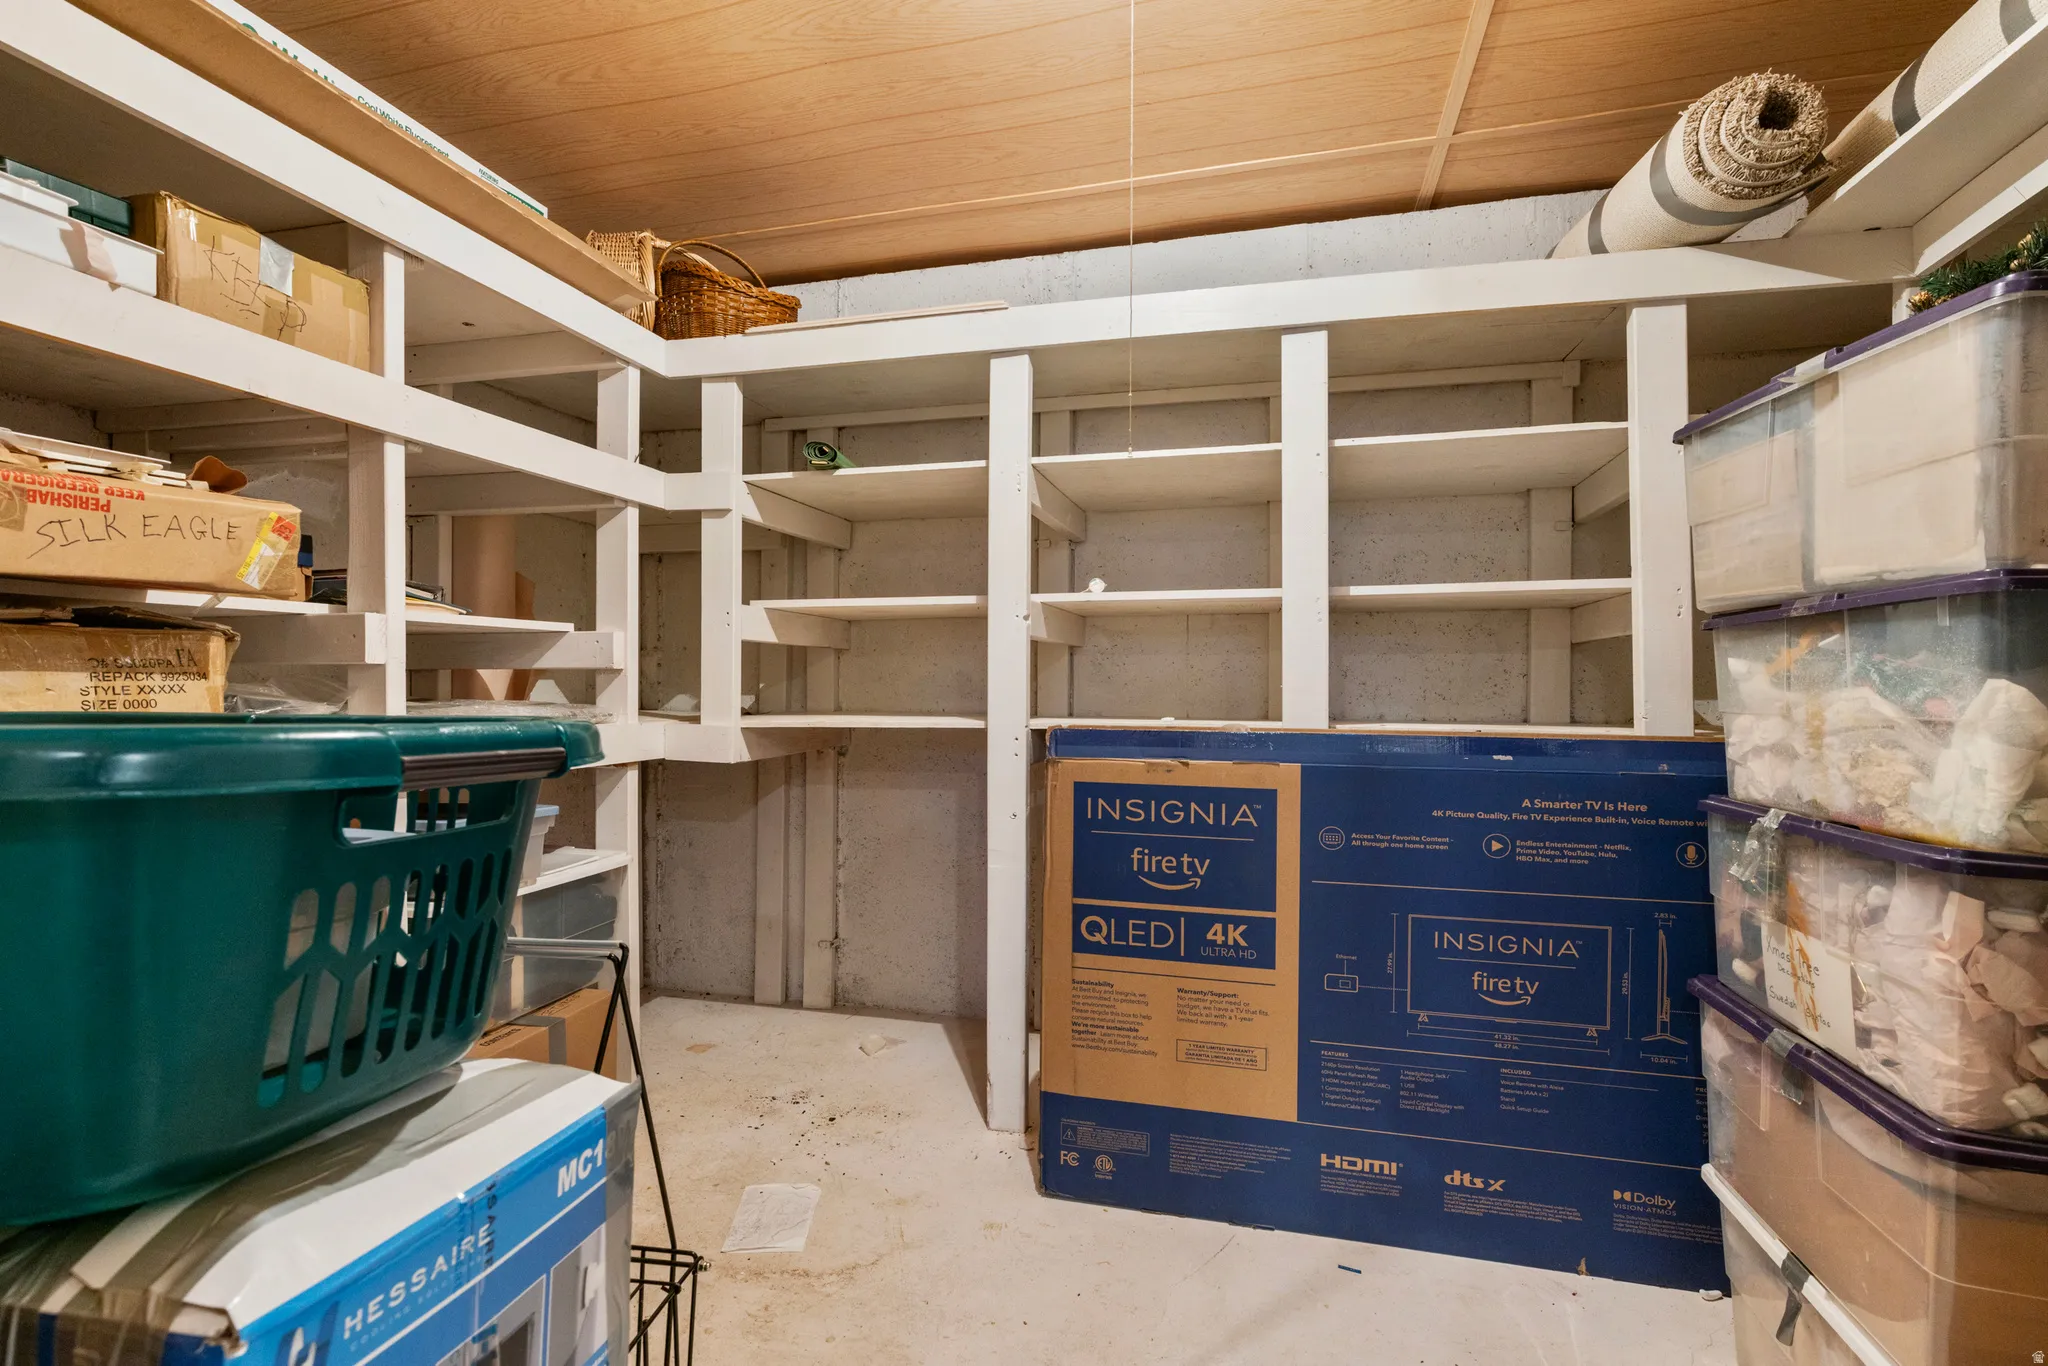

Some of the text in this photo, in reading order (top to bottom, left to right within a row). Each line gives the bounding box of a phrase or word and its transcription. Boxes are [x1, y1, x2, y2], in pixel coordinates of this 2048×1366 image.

[105, 486, 145, 501] KEEP
[26, 514, 242, 559] SILK EAGLE
[89, 672, 208, 682] REPACK 9925034
[80, 684, 187, 697] STYLE XXXXX
[81, 698, 158, 711] SIZE 0000
[1522, 799, 1648, 812] A Smarter TV Is Here
[1446, 811, 1475, 819] Picture
[1477, 811, 1511, 821] Quality,
[1530, 813, 1541, 821] TV
[1543, 814, 1593, 825] Experience
[1595, 816, 1630, 825] Built-in,
[1631, 817, 1656, 826] Voice
[1658, 818, 1694, 827] Remote
[1080, 915, 1175, 948] QLED
[1206, 923, 1249, 947] 4K
[1200, 947, 1257, 960] ULTRA HD
[1767, 935, 1791, 963] Xmas
[1072, 979, 1114, 989] Sustainability
[1177, 988, 1239, 998] Warranty/Support:
[1120, 998, 1149, 1006] protecting
[1072, 1035, 1106, 1044] Sustainability
[1634, 1192, 1676, 1209] Dolby
[343, 1223, 494, 1340] HESSAIRE
